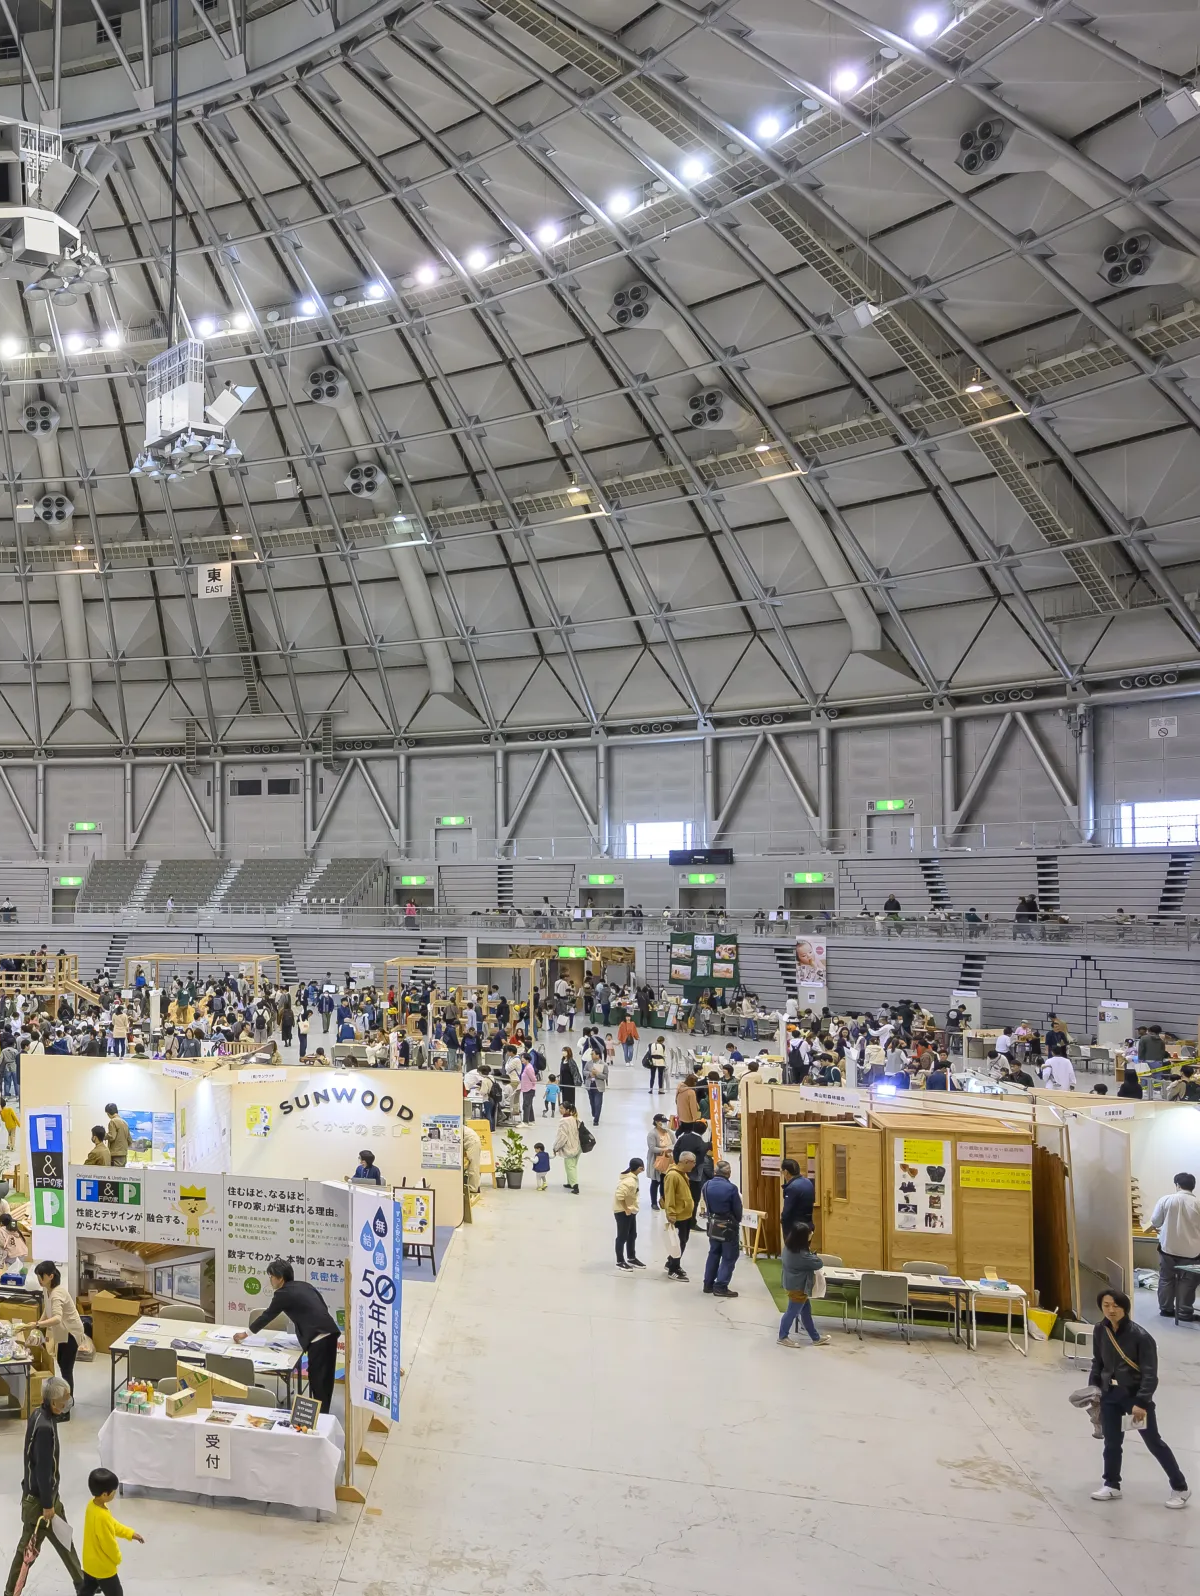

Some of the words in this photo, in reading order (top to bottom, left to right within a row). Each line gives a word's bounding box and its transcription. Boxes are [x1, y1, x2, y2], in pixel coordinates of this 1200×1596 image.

[207, 567, 222, 583] 東
[205, 584, 224, 594] EAST
[279, 1087, 414, 1121] SUNWOOD
[36, 1117, 57, 1150] F
[42, 1155, 57, 1177] &
[35, 1177, 63, 1189] FPの家
[80, 1180, 94, 1200] F
[103, 1182, 115, 1196] &
[123, 1183, 137, 1203] P
[227, 1186, 311, 1202] 住むほど、なるほど。
[42, 1191, 60, 1224] P
[227, 1199, 340, 1218] 「FPの家」が選ばれる理由。
[76, 1221, 142, 1236] からだにいい家。
[375, 1218, 386, 1234] 無
[362, 1232, 372, 1248] 結
[359, 1268, 397, 1305] 50
[367, 1299, 388, 1389] 年保証
[205, 1433, 221, 1470] 受付
